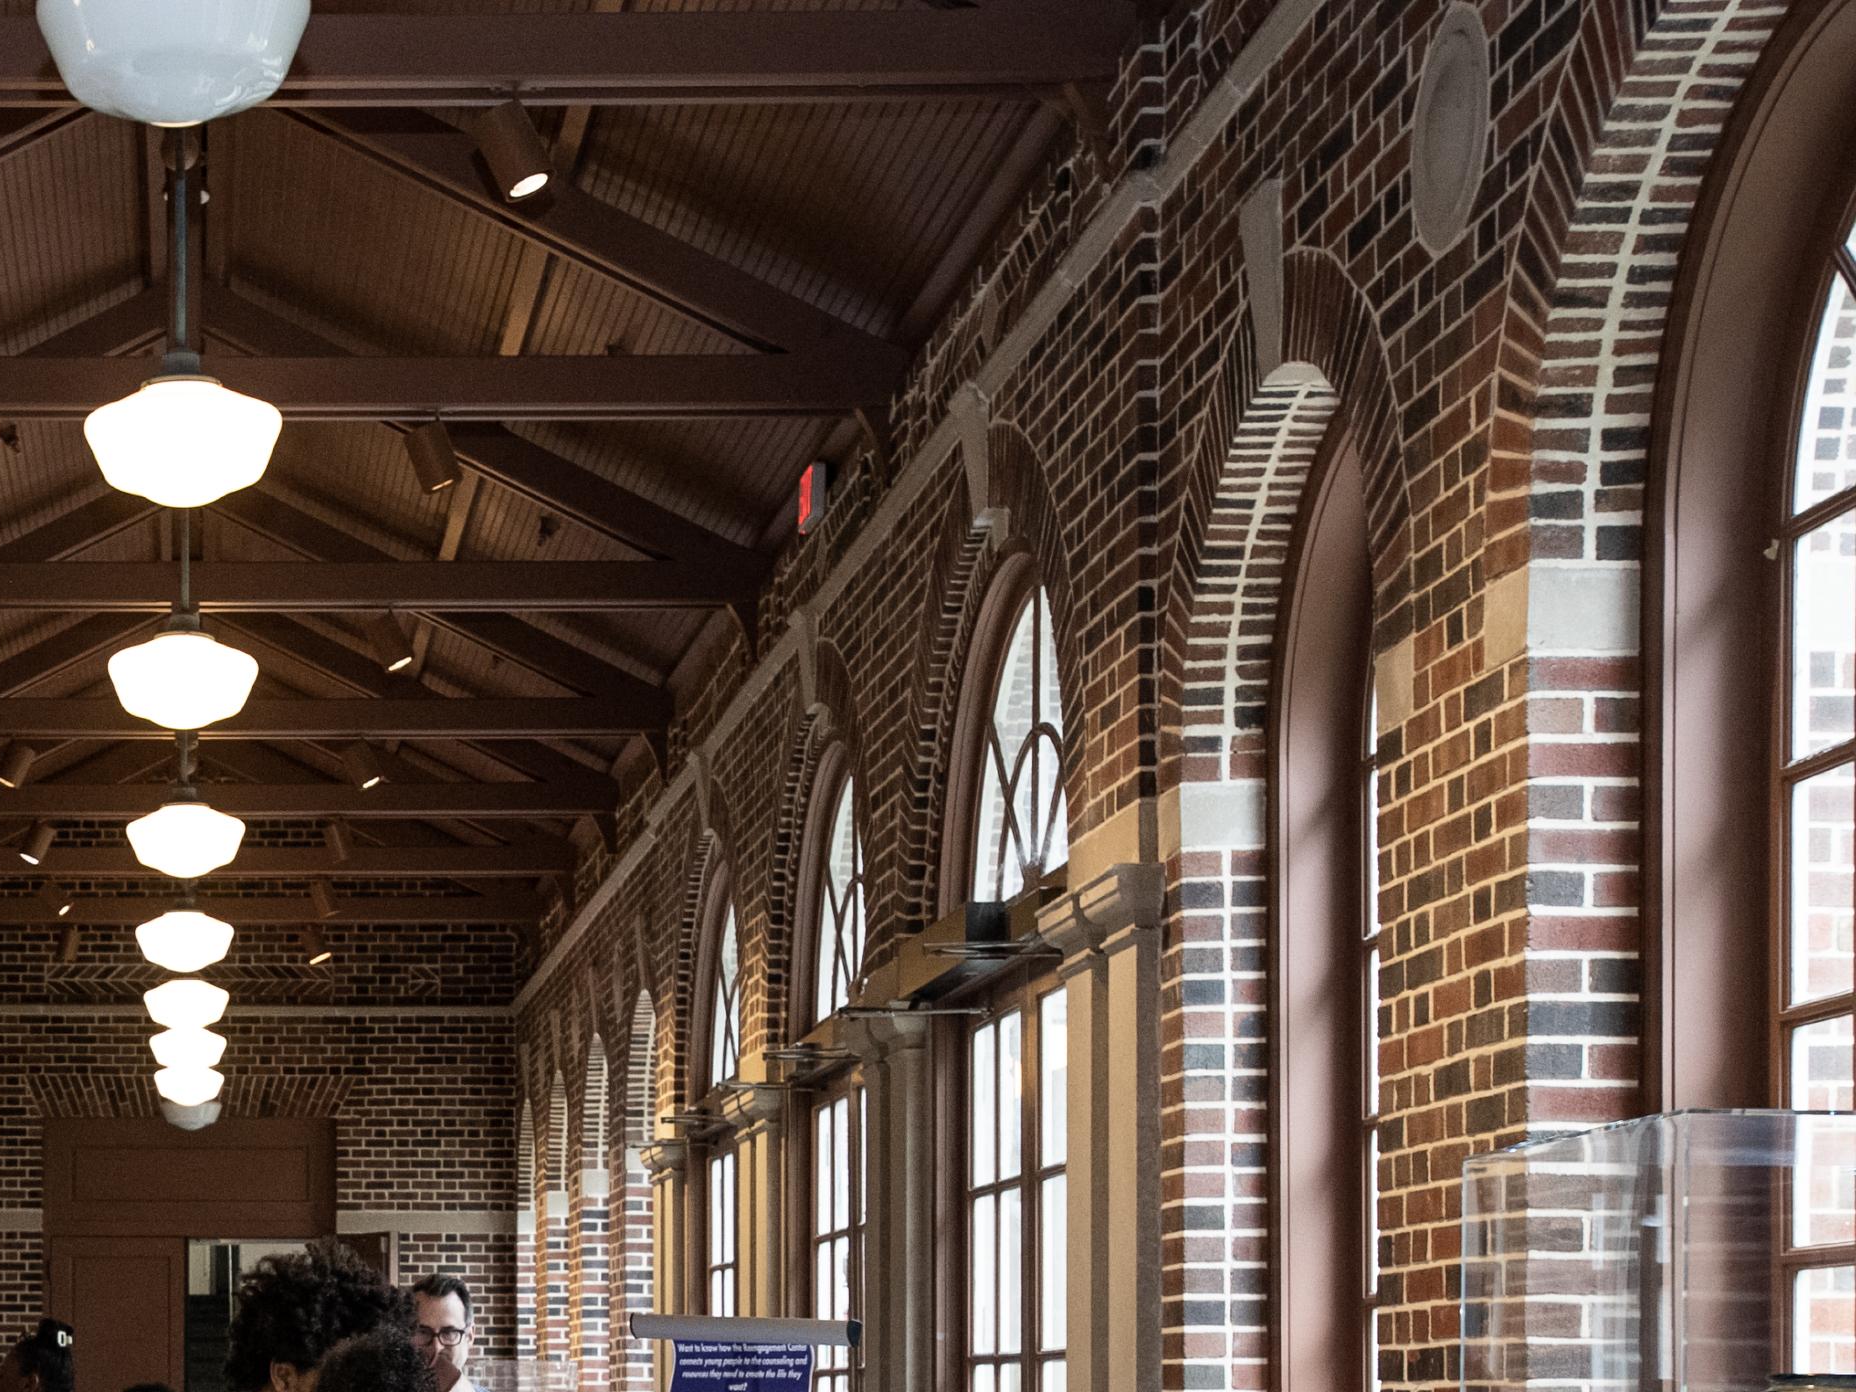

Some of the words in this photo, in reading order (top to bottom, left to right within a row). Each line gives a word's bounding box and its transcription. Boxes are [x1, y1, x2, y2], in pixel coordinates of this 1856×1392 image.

[677, 1343, 693, 1353] Want
[701, 1342, 718, 1353] know
[718, 1343, 731, 1353] how
[732, 1343, 742, 1352] the
[787, 1342, 807, 1352] Center
[704, 1358, 723, 1367] young
[723, 1356, 743, 1367] people
[750, 1355, 761, 1366] the
[761, 1355, 794, 1367] counseling
[795, 1355, 808, 1366] and
[709, 1368, 722, 1380] they
[723, 1368, 738, 1378] need
[745, 1370, 764, 1378] create
[765, 1368, 776, 1378] the
[776, 1368, 787, 1378] life
[787, 1368, 802, 1380] they
[728, 1382, 747, 1391] want?
